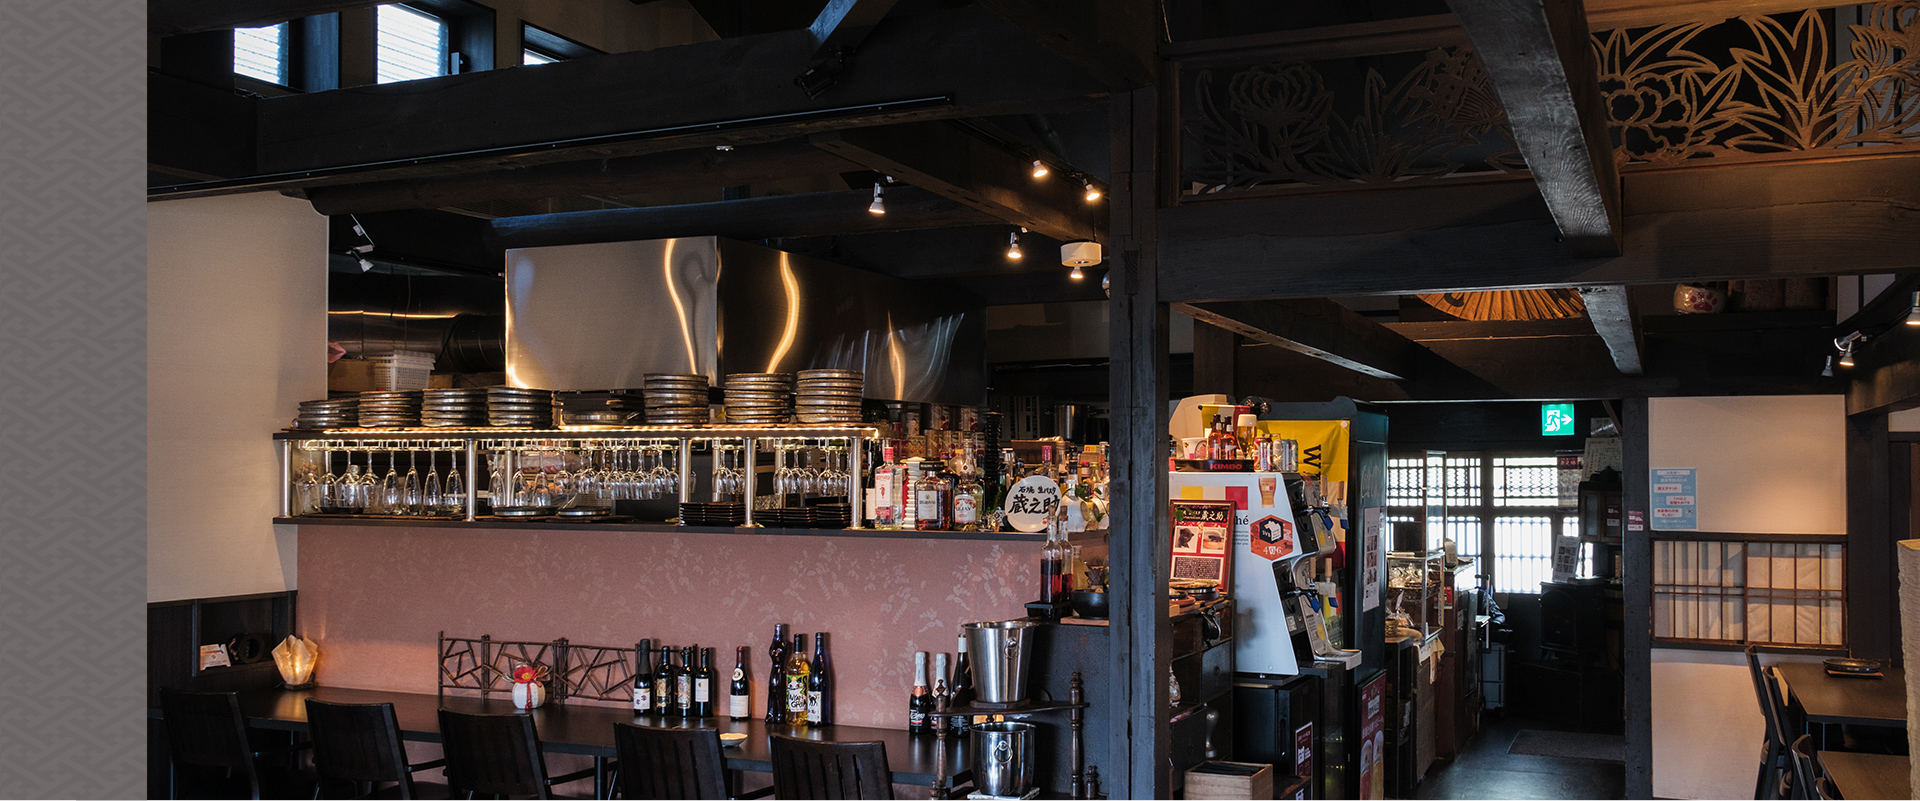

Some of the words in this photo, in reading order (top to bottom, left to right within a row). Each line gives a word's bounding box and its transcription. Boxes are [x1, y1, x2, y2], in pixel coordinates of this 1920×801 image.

[1018, 486, 1035, 494] 石焼
[1037, 486, 1057, 496] 生パスタ
[1008, 493, 1060, 514] 蔵之助
